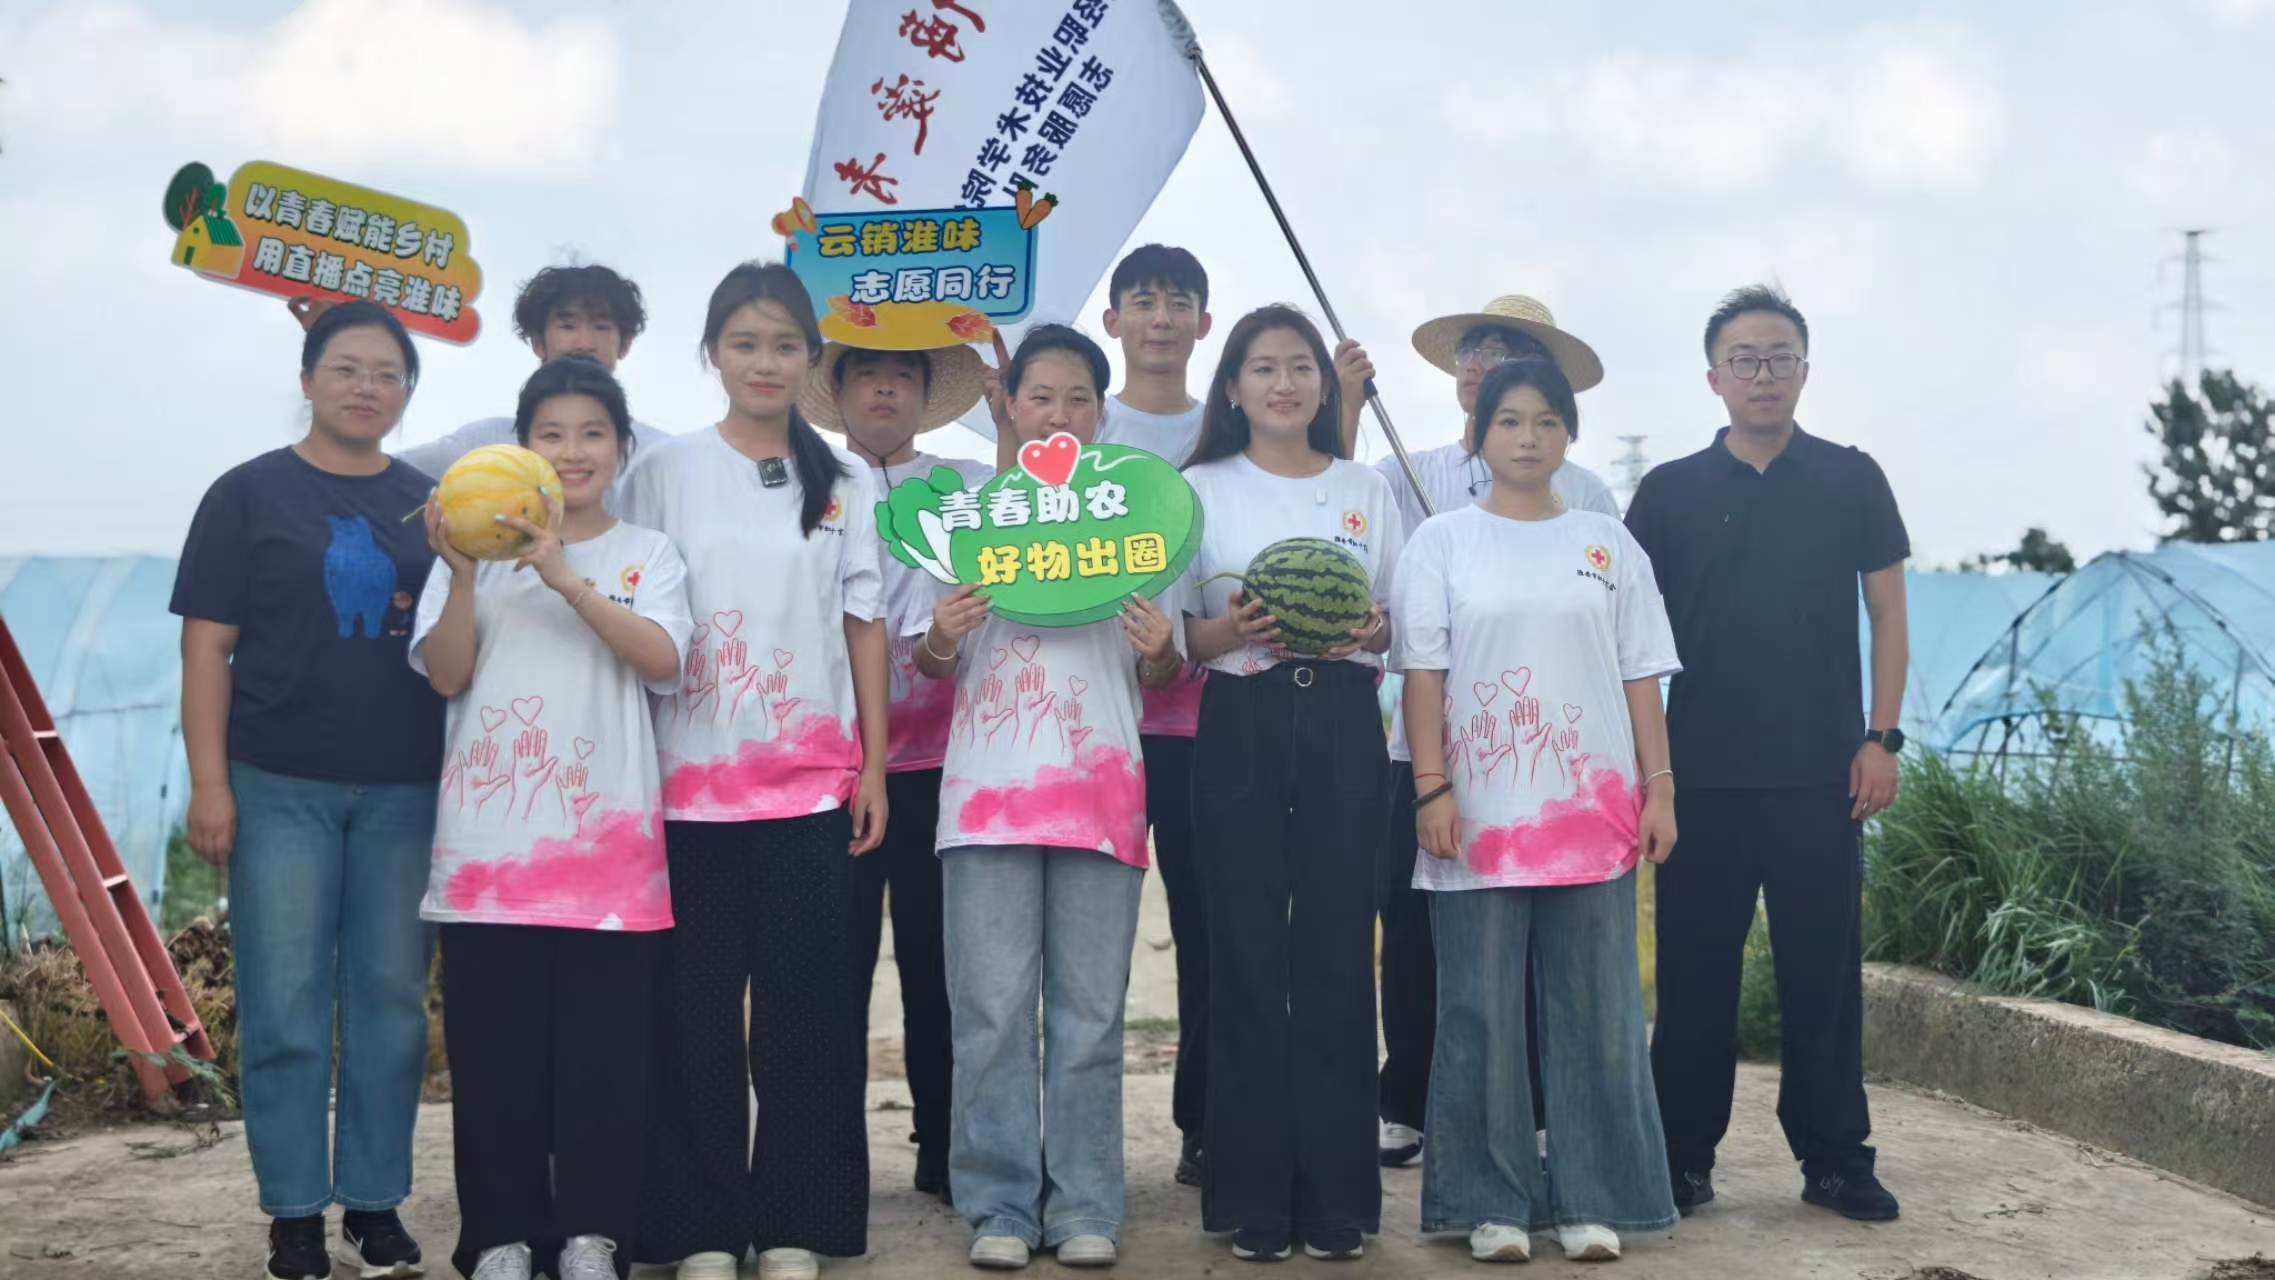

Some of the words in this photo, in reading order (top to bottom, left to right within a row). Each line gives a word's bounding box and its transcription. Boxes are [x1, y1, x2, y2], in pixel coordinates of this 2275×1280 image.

[244, 183, 454, 269] 以青春赋能乡村
[818, 219, 983, 257] 云销淮味
[252, 236, 461, 322] 用直播点亮淮味
[850, 265, 1015, 304] 志愿同行
[938, 480, 1129, 531] 青春助农
[977, 532, 1167, 586] 好物出圈
